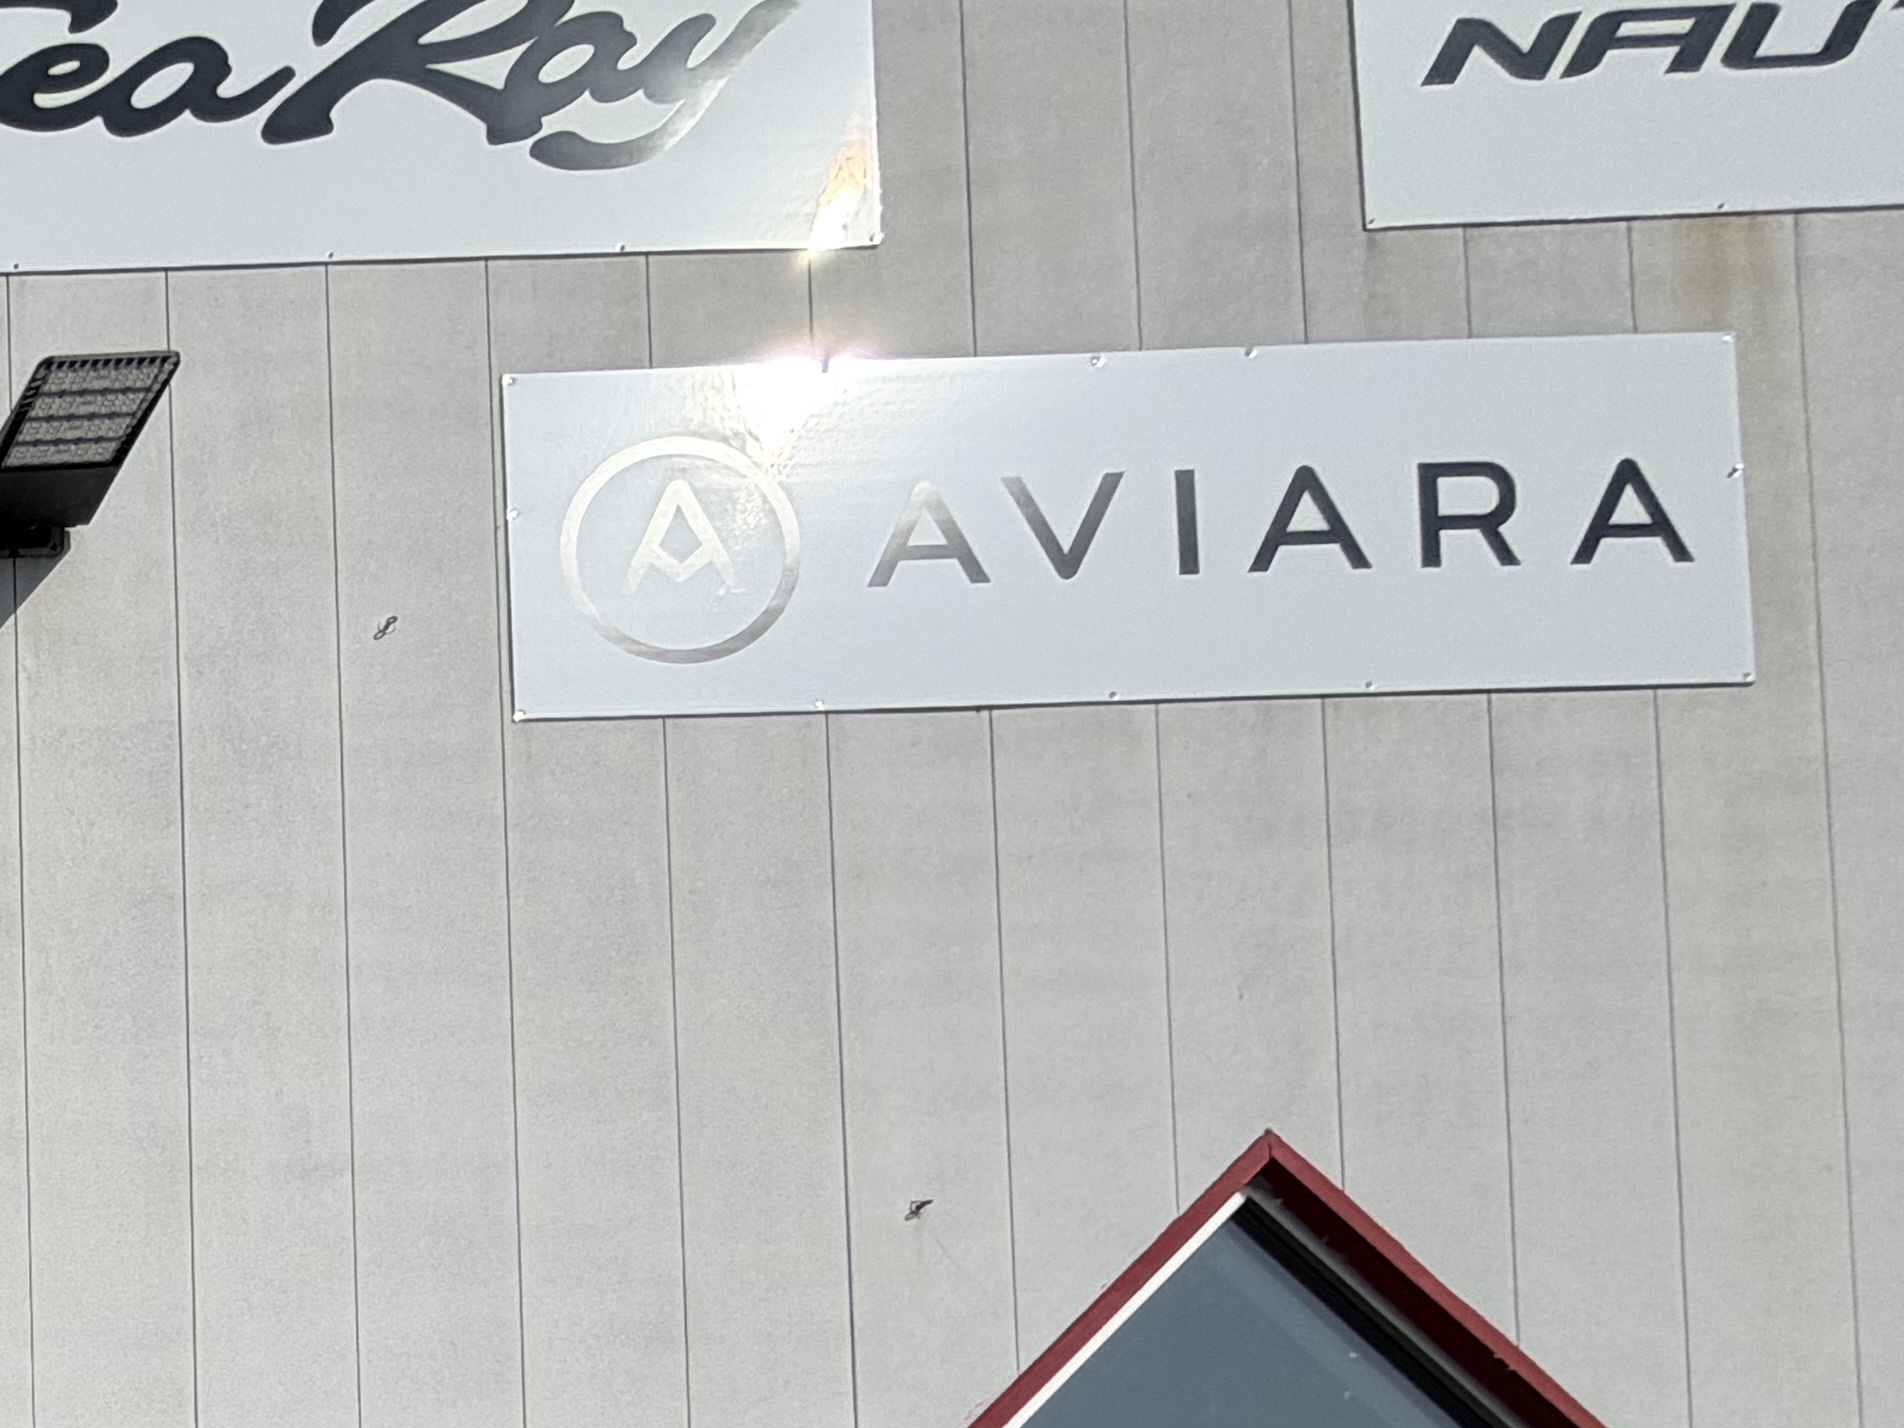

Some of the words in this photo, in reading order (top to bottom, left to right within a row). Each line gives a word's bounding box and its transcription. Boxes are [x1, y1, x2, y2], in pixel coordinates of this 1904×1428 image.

[260, 0, 798, 171] Ray
[1420, 0, 1904, 87] NAU
[867, 457, 1695, 588] AVIARA
